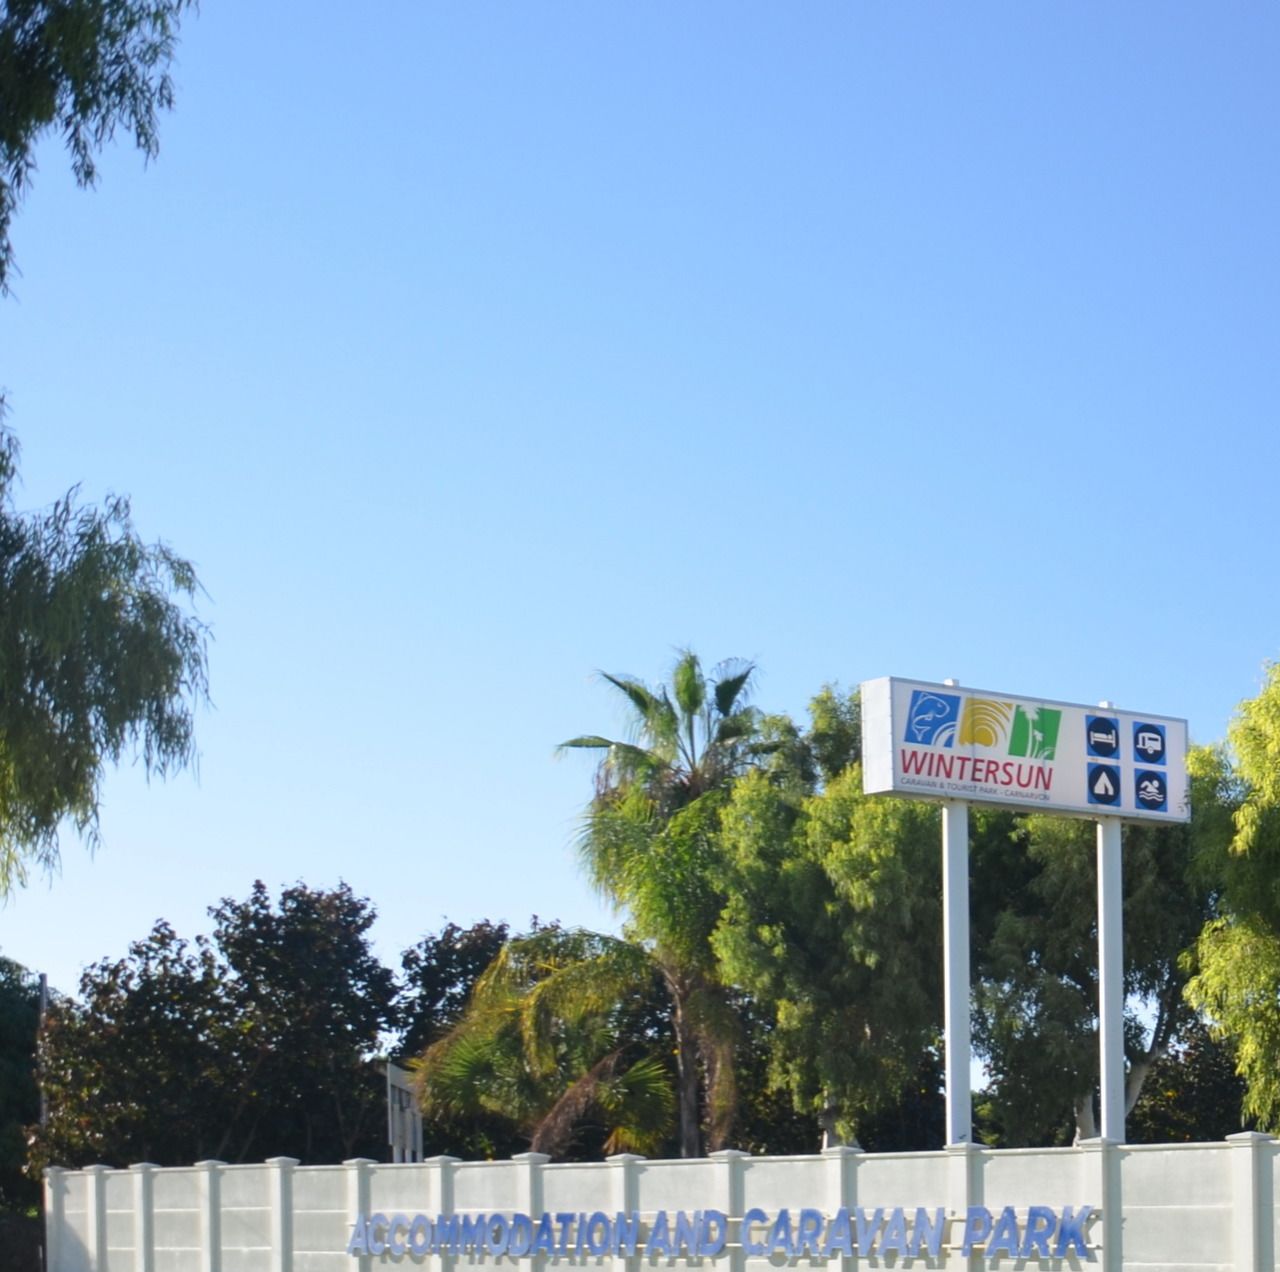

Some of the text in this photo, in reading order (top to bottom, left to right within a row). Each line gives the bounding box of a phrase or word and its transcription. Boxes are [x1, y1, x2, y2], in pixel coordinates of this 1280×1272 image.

[901, 749, 1053, 791] WINTERSUN
[901, 777, 937, 789] CARAVAN
[947, 783, 977, 793] TOURIST
[979, 787, 998, 795] PARK
[350, 1205, 1095, 1259] ACCOMMODATION AND CARAVAN PARK
